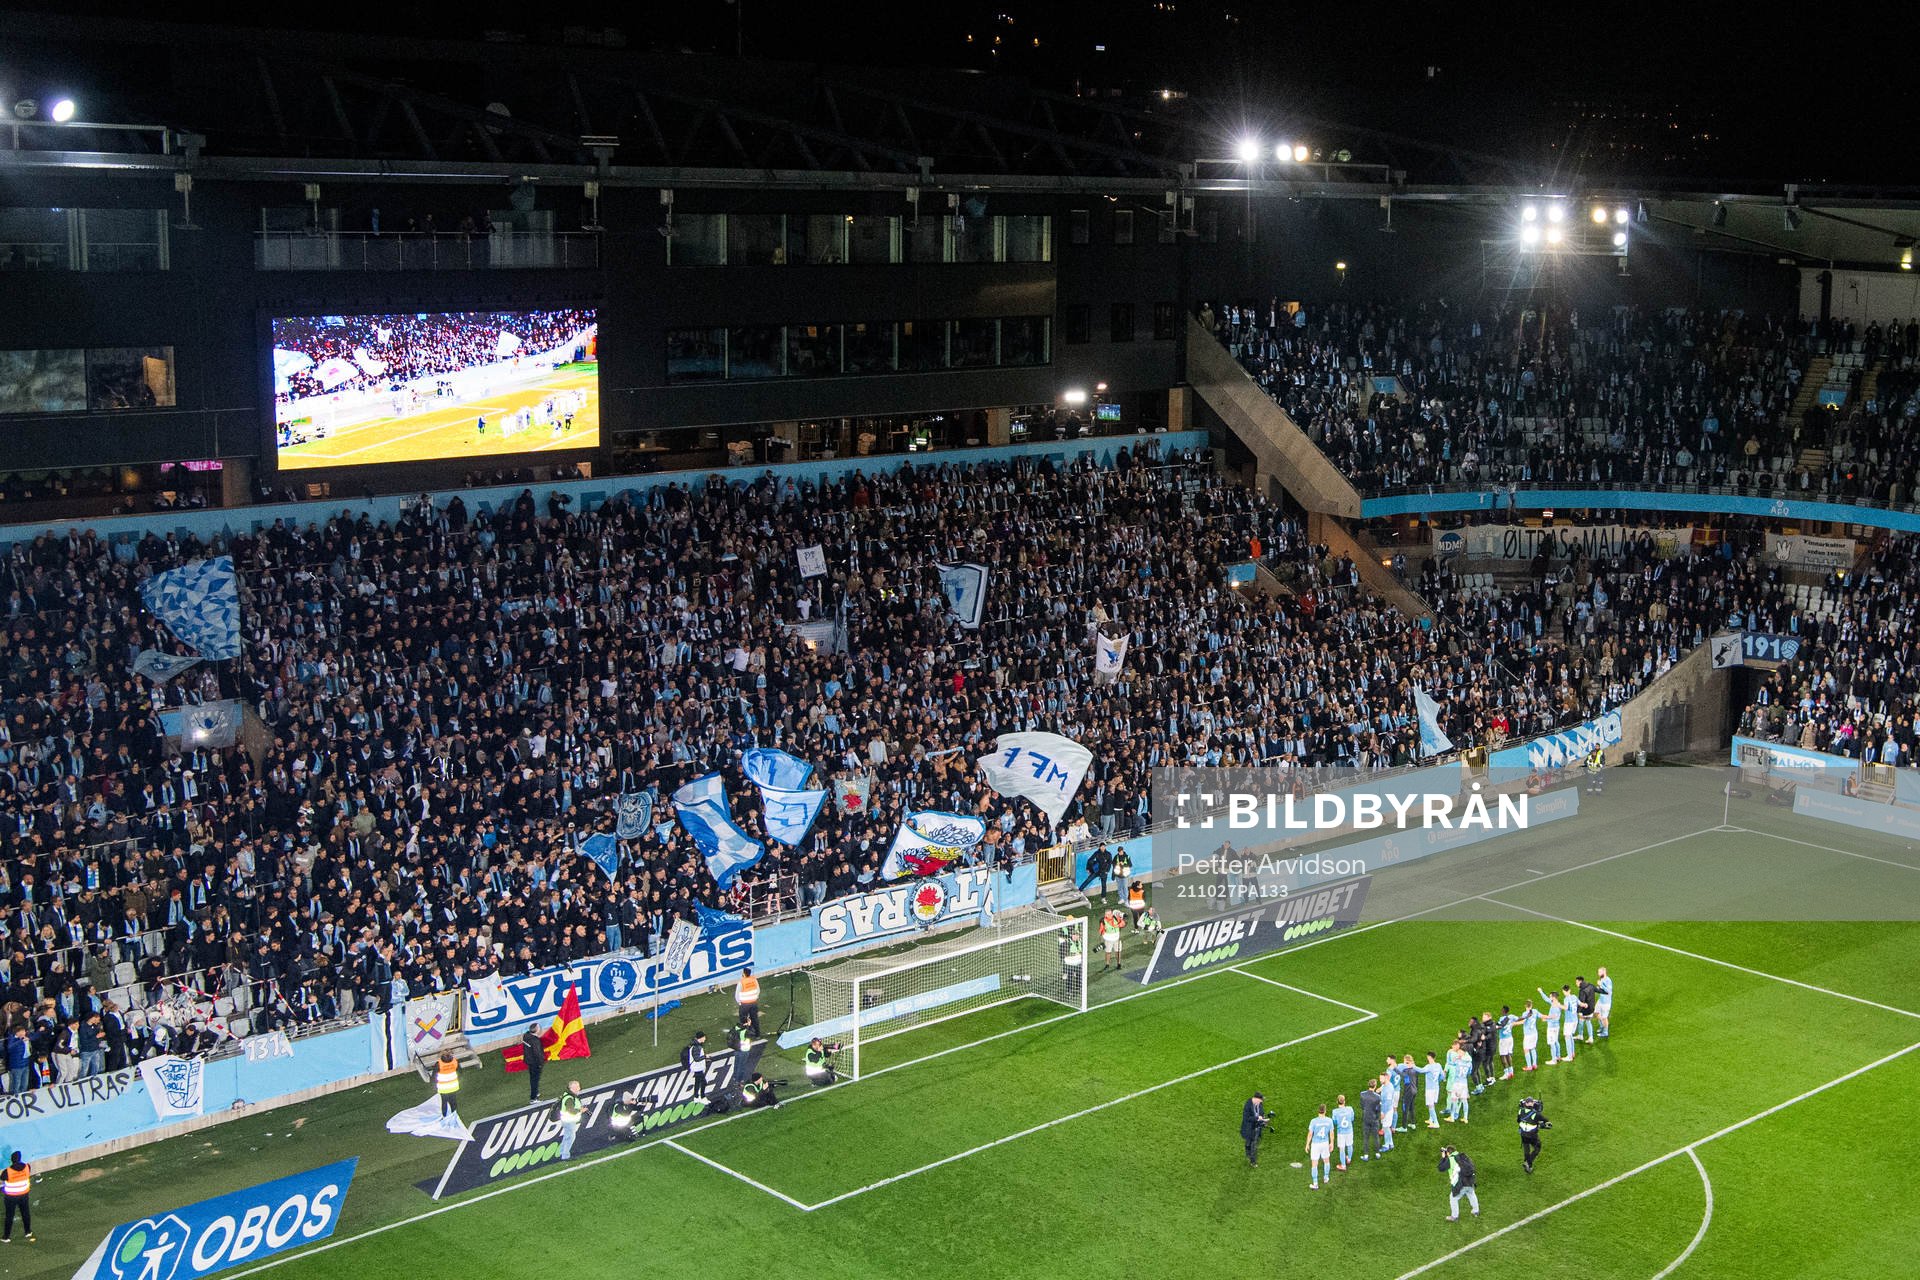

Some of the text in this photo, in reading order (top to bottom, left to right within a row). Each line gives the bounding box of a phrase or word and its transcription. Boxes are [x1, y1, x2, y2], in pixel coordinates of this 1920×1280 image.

[1275, 883, 1359, 927] UNIBET
[1174, 908, 1266, 958] UNIBET
[48, 1072, 130, 1109] ULTRAS
[481, 1090, 615, 1160] UNIBT
[1341, 1116, 1349, 1128] 6
[191, 1184, 339, 1272] OBOS
